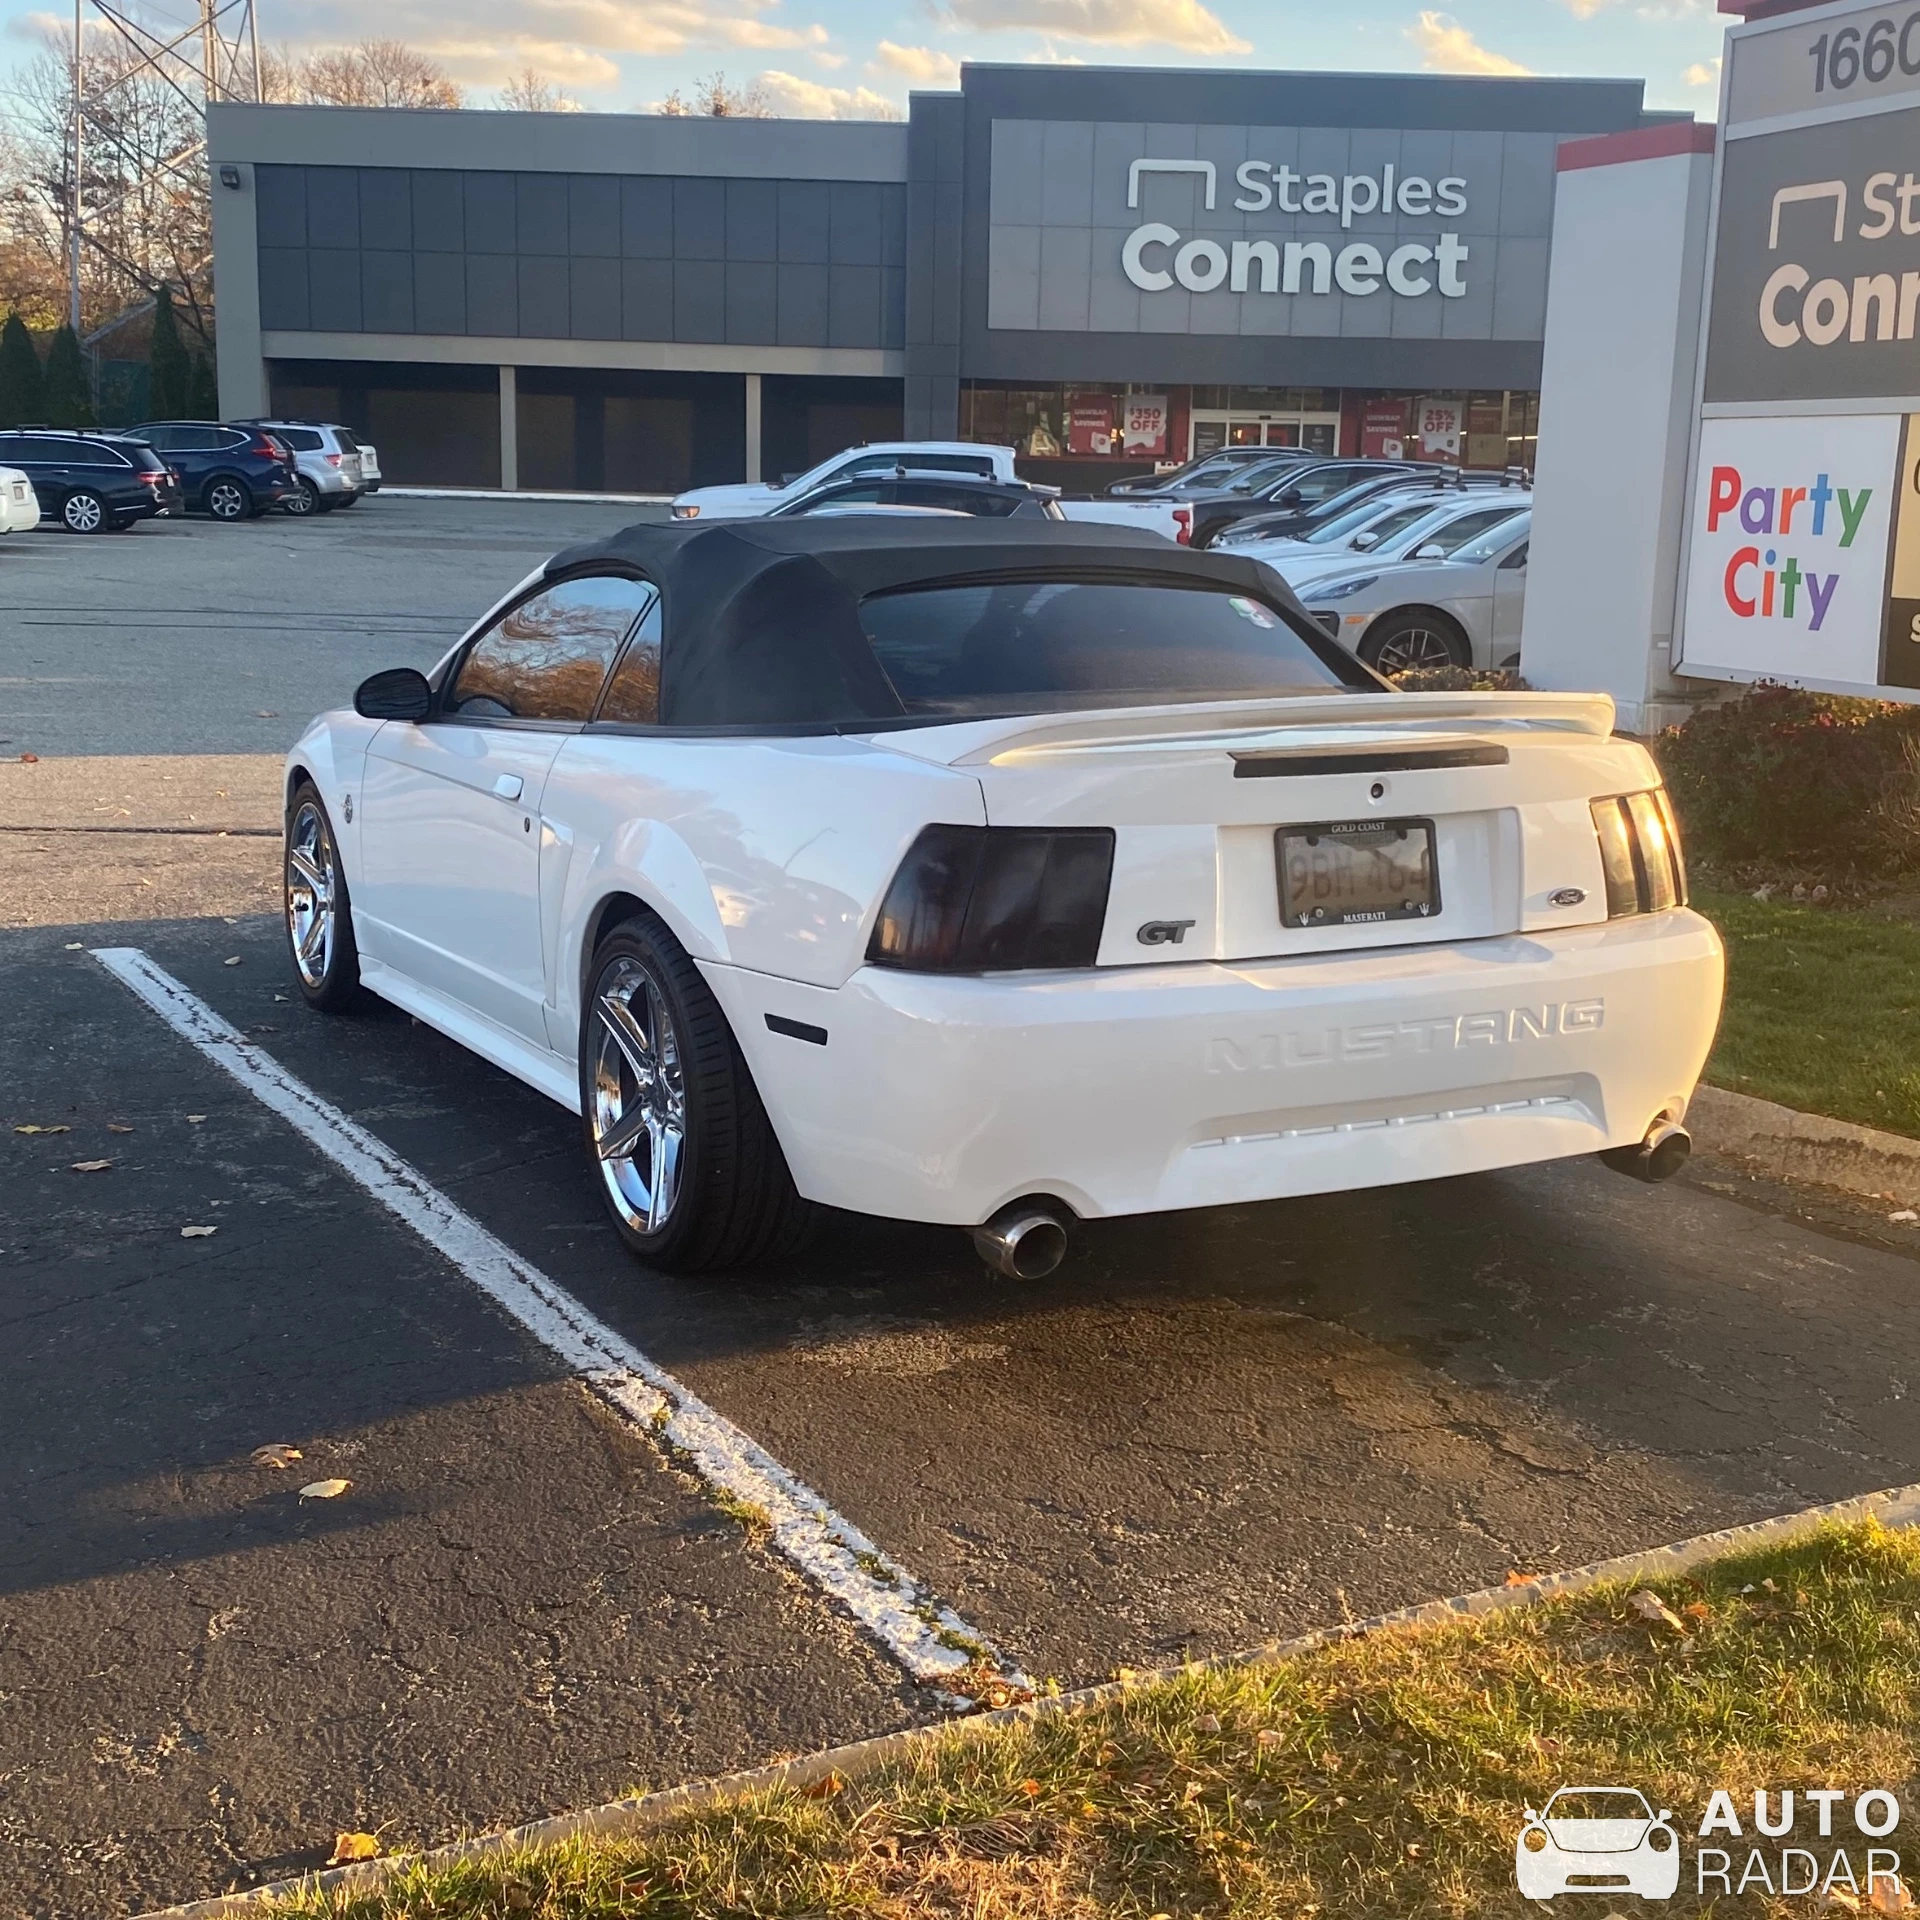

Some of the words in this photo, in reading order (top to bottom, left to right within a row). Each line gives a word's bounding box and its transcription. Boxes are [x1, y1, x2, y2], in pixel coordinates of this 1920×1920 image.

[1808, 11, 1920, 93] 1660
[1234, 160, 1467, 228] Staples
[1122, 222, 1469, 297] Connect
[1129, 406, 1162, 419] $350
[1425, 409, 1456, 421] 25%
[1073, 419, 1106, 428] SAVINGS
[1130, 420, 1160, 432] OFF
[1366, 425, 1398, 433] SAVINGS
[1423, 421, 1454, 433] OFF
[1707, 466, 1873, 548] Party
[1724, 546, 1840, 631] City
[1331, 825, 1356, 834] GOLD
[1357, 822, 1386, 832] COAST
[1343, 911, 1386, 923] MASERATI
[1136, 919, 1196, 946] GT
[1205, 997, 1604, 1075] MUSTANG
